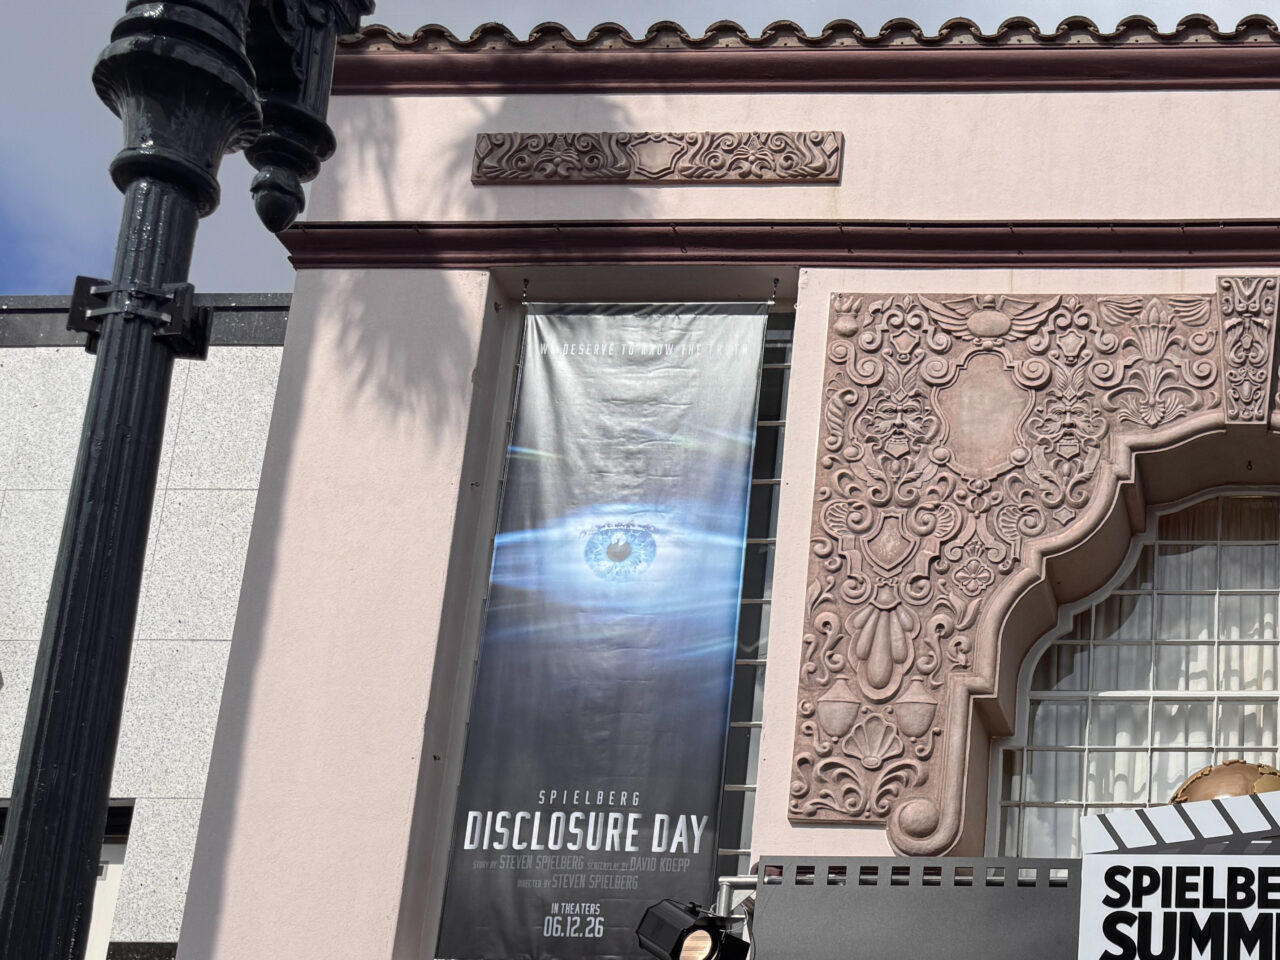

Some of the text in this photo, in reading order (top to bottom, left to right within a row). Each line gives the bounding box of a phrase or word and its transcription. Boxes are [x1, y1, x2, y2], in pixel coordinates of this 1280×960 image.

[562, 343, 615, 356] DESERVE
[621, 343, 635, 356] TO
[681, 343, 702, 356] THE
[539, 790, 640, 806] SPIELBERG
[464, 811, 709, 854] DISCLOSURE DAY
[499, 855, 533, 870] STEVEN
[536, 855, 585, 871] SPIELBERG
[630, 856, 657, 872] DAVID
[660, 857, 690, 872] KOEPP
[552, 874, 586, 889] STEVEN
[589, 874, 639, 890] SPIELBERG
[551, 903, 600, 915] IN THEATERS
[543, 916, 604, 938] 06.12.26
